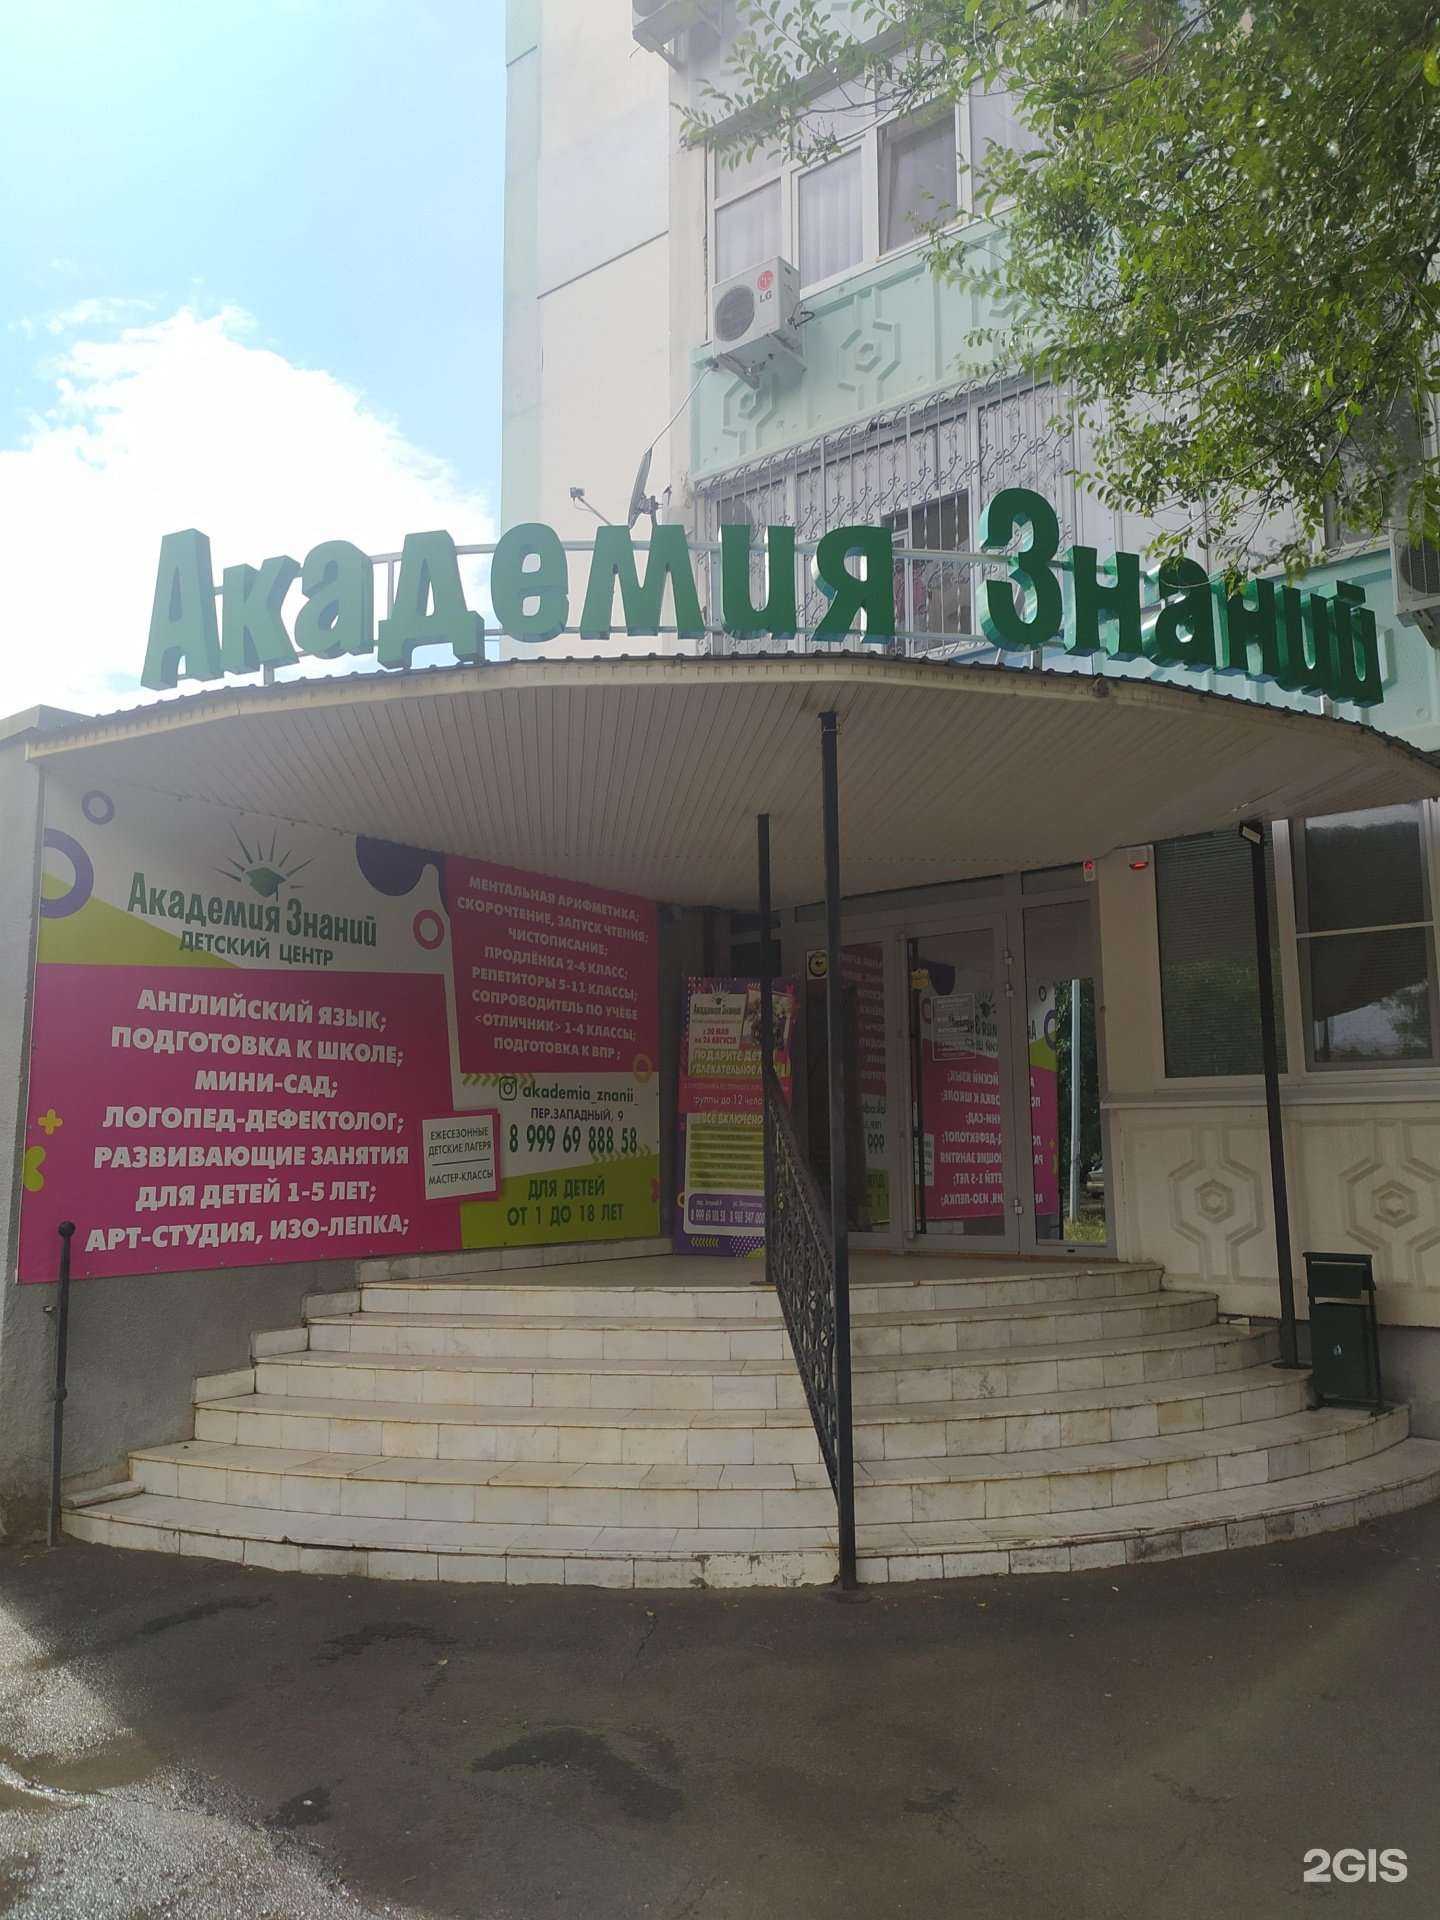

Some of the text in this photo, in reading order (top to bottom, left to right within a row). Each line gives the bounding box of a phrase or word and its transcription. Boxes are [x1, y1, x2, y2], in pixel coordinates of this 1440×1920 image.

[759, 290, 773, 303] LG
[140, 487, 1384, 707] Академия Знаний
[127, 872, 377, 946] Академия Знаний
[468, 876, 640, 922] МЕНТАЛЬНАЯ АРИФМЕТИКА;
[457, 896, 648, 943] СКОРОЧТЕНИЕ, ЗАПУСК ЧТЕНИЯ;
[179, 931, 334, 966] ДЕТСКИЙ ЦЕНТР
[508, 928, 609, 957] ЧИСТОПИСАНИЕ;
[484, 946, 629, 980] ПРОДЛЁНКА 2-4 КЛАСС;
[472, 966, 639, 1002] РЕПЕТИТОРЫ 5-11 КЛАССЫ;
[137, 989, 387, 1032] АНГЛИЙСКИЙ ЯЗЫК;
[472, 990, 584, 1014] СОПРОВОДИТЕЛЬ
[585, 1003, 603, 1016] ПО
[564, 1022, 585, 1035] 1-4
[586, 1022, 637, 1042] КЛАССЫ;
[111, 1026, 404, 1067] ПОДГОТОВКА К ШКОЛЕ;
[493, 1037, 579, 1057] ПОДГОТОВКА
[580, 1044, 590, 1056] К
[194, 1070, 338, 1098] МИНИ-САД;
[523, 1082, 639, 1106] akademia_znanii_
[102, 1106, 404, 1133] ЛОГОПЕД-ДЕФЕКТОЛОГ;
[617, 1111, 624, 1121] 9
[430, 1126, 489, 1141] ЕЖЕСЕЗОННЫЕ
[509, 1124, 638, 1153] 8 999 69 888 58
[94, 1146, 409, 1169] РАЗВИВАЮЩИЕ ЗАНЯТИЯ
[428, 1140, 491, 1158] ДЕТСКИЕ ЛАГЕРЯ
[428, 1169, 494, 1185] МАСТЕР-КЛАССЫ
[528, 1175, 605, 1200] ДЛЯ ДЕТЕЙ
[135, 1178, 377, 1212] ДЛЯ ДЕТЕЙ 1-5 ЛЕТ;
[507, 1203, 625, 1226] ОТ 1 ДО 18 ЛЕТ
[84, 1214, 410, 1252] АРТ-СТУДИЯ, ИЗО-ЛЕПКА;
